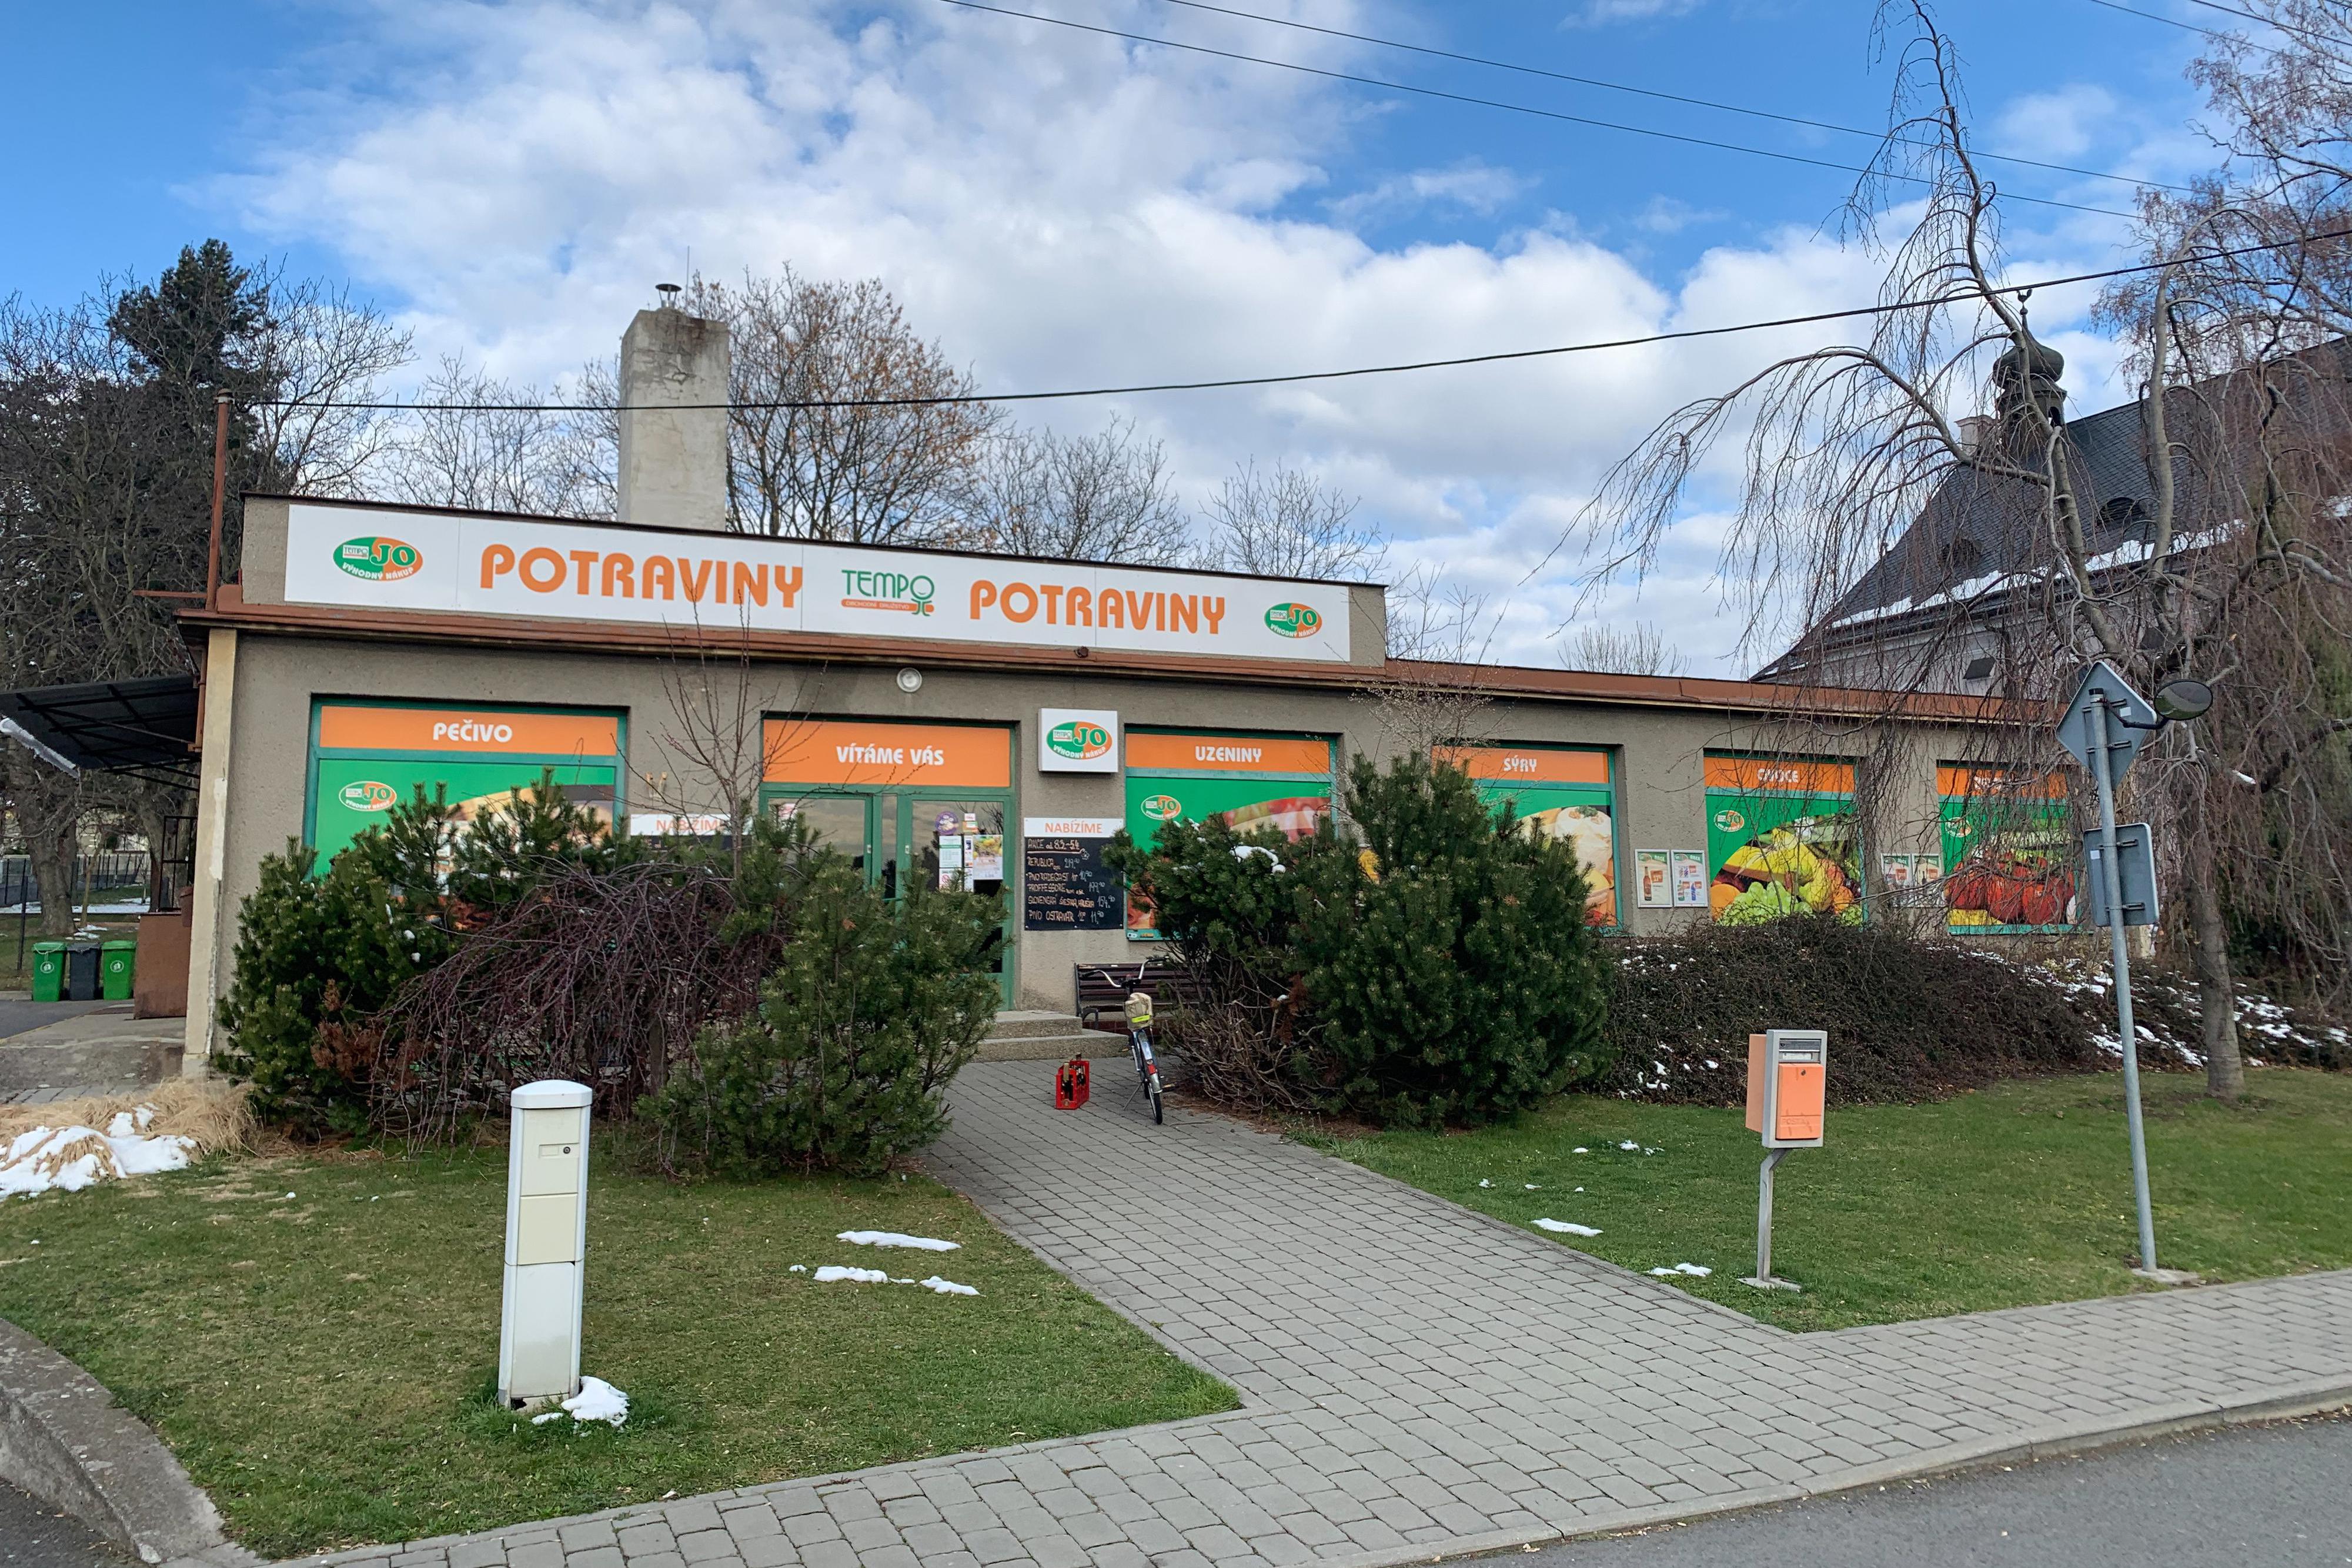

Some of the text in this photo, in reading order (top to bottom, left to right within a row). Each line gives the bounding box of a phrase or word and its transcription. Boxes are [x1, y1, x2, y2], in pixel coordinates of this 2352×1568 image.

[370, 543, 417, 568] JO
[342, 561, 414, 580] VÝHODNÝ NÁKUP
[480, 543, 803, 608] POTRAVINY
[841, 569, 935, 603] TEMPO
[970, 579, 1225, 635] POTRAVINY
[1287, 608, 1318, 627] JO
[1270, 623, 1297, 637] VÝHODNÝ
[433, 718, 513, 743] PEČIVO
[1073, 727, 1108, 747] JO
[836, 743, 944, 765] VÍTÁME VÁS
[1053, 744, 1084, 758] VÝHODNÝ
[1195, 745, 1262, 763] UZENINY
[1503, 754, 1538, 773] SÝRY
[362, 786, 392, 801] JO
[1157, 799, 1177, 811] JO
[1044, 819, 1102, 834] NABÍZÍME
